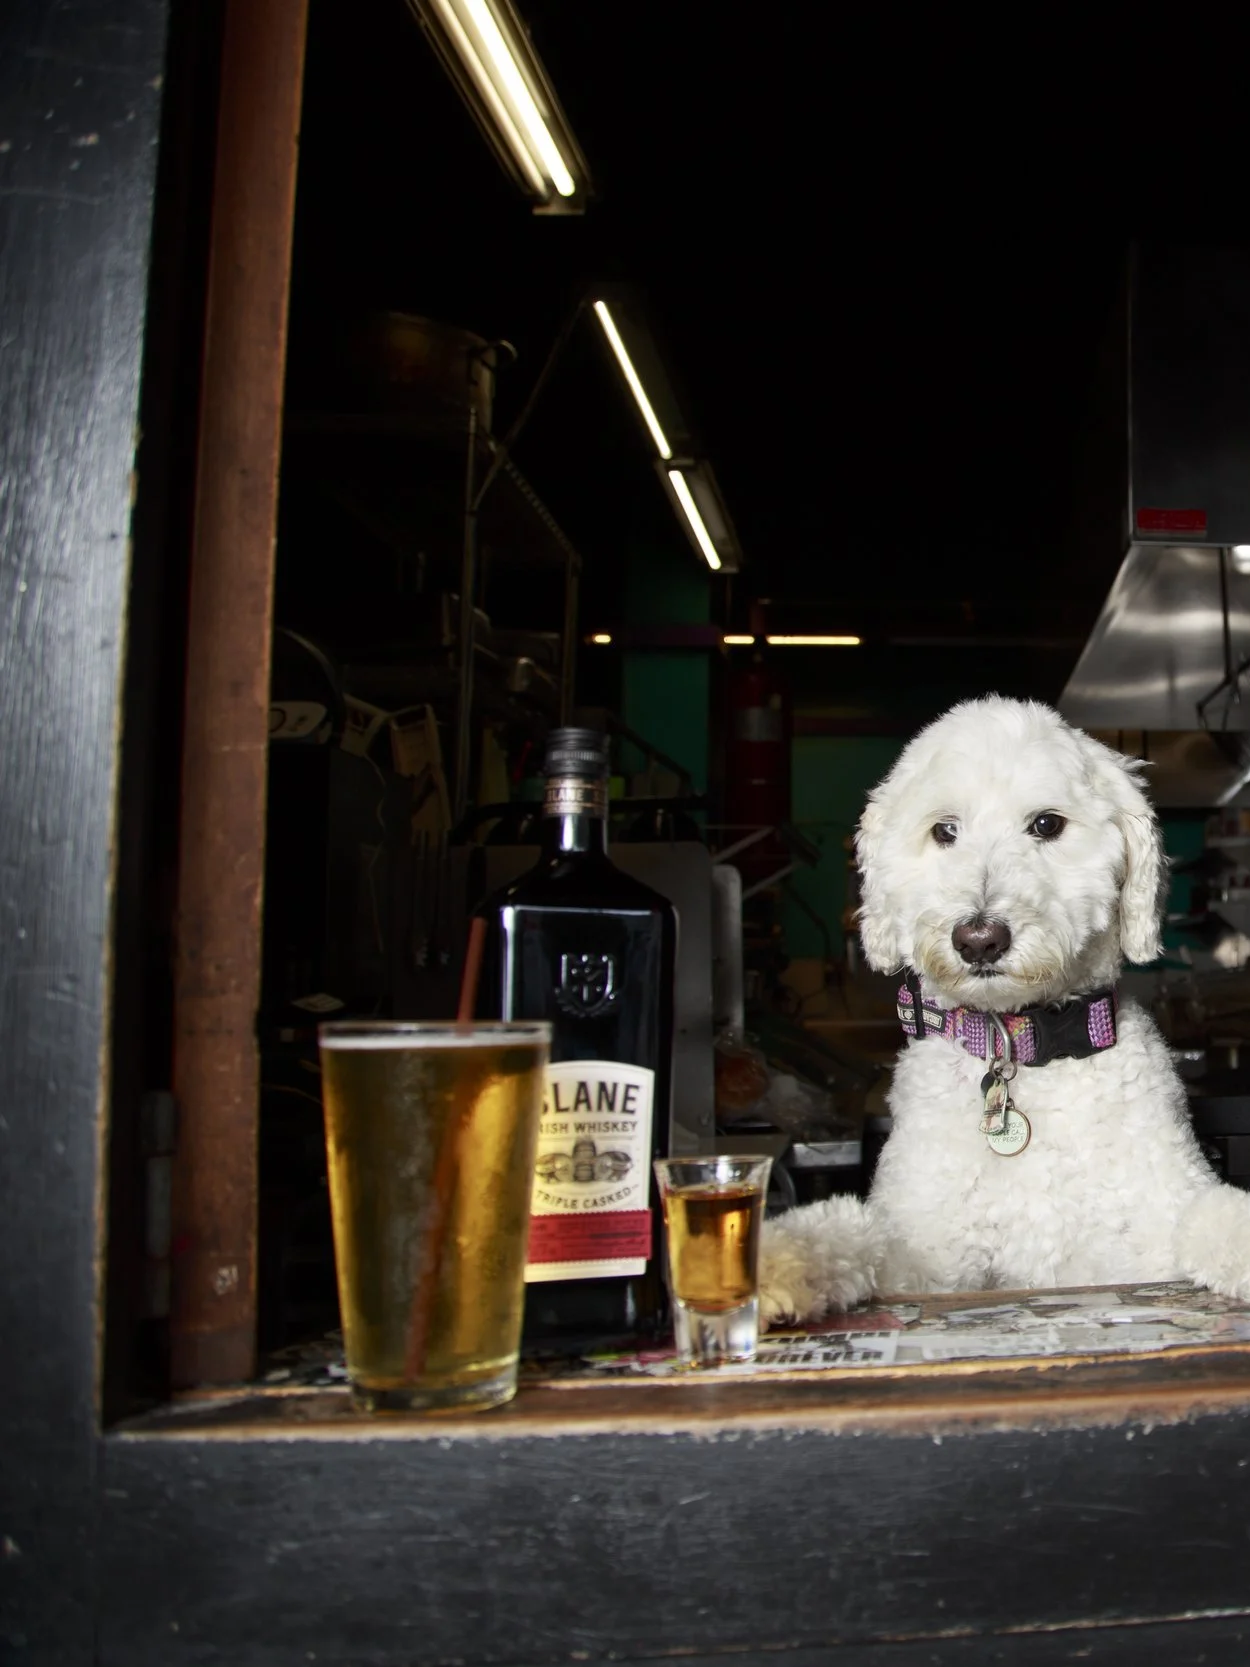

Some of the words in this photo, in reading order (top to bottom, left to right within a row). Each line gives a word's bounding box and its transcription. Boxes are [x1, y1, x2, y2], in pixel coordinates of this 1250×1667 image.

[574, 1120, 639, 1134] WHISKEY
[536, 1190, 577, 1209] TRIPLE
[583, 1187, 631, 1209] CASKED
